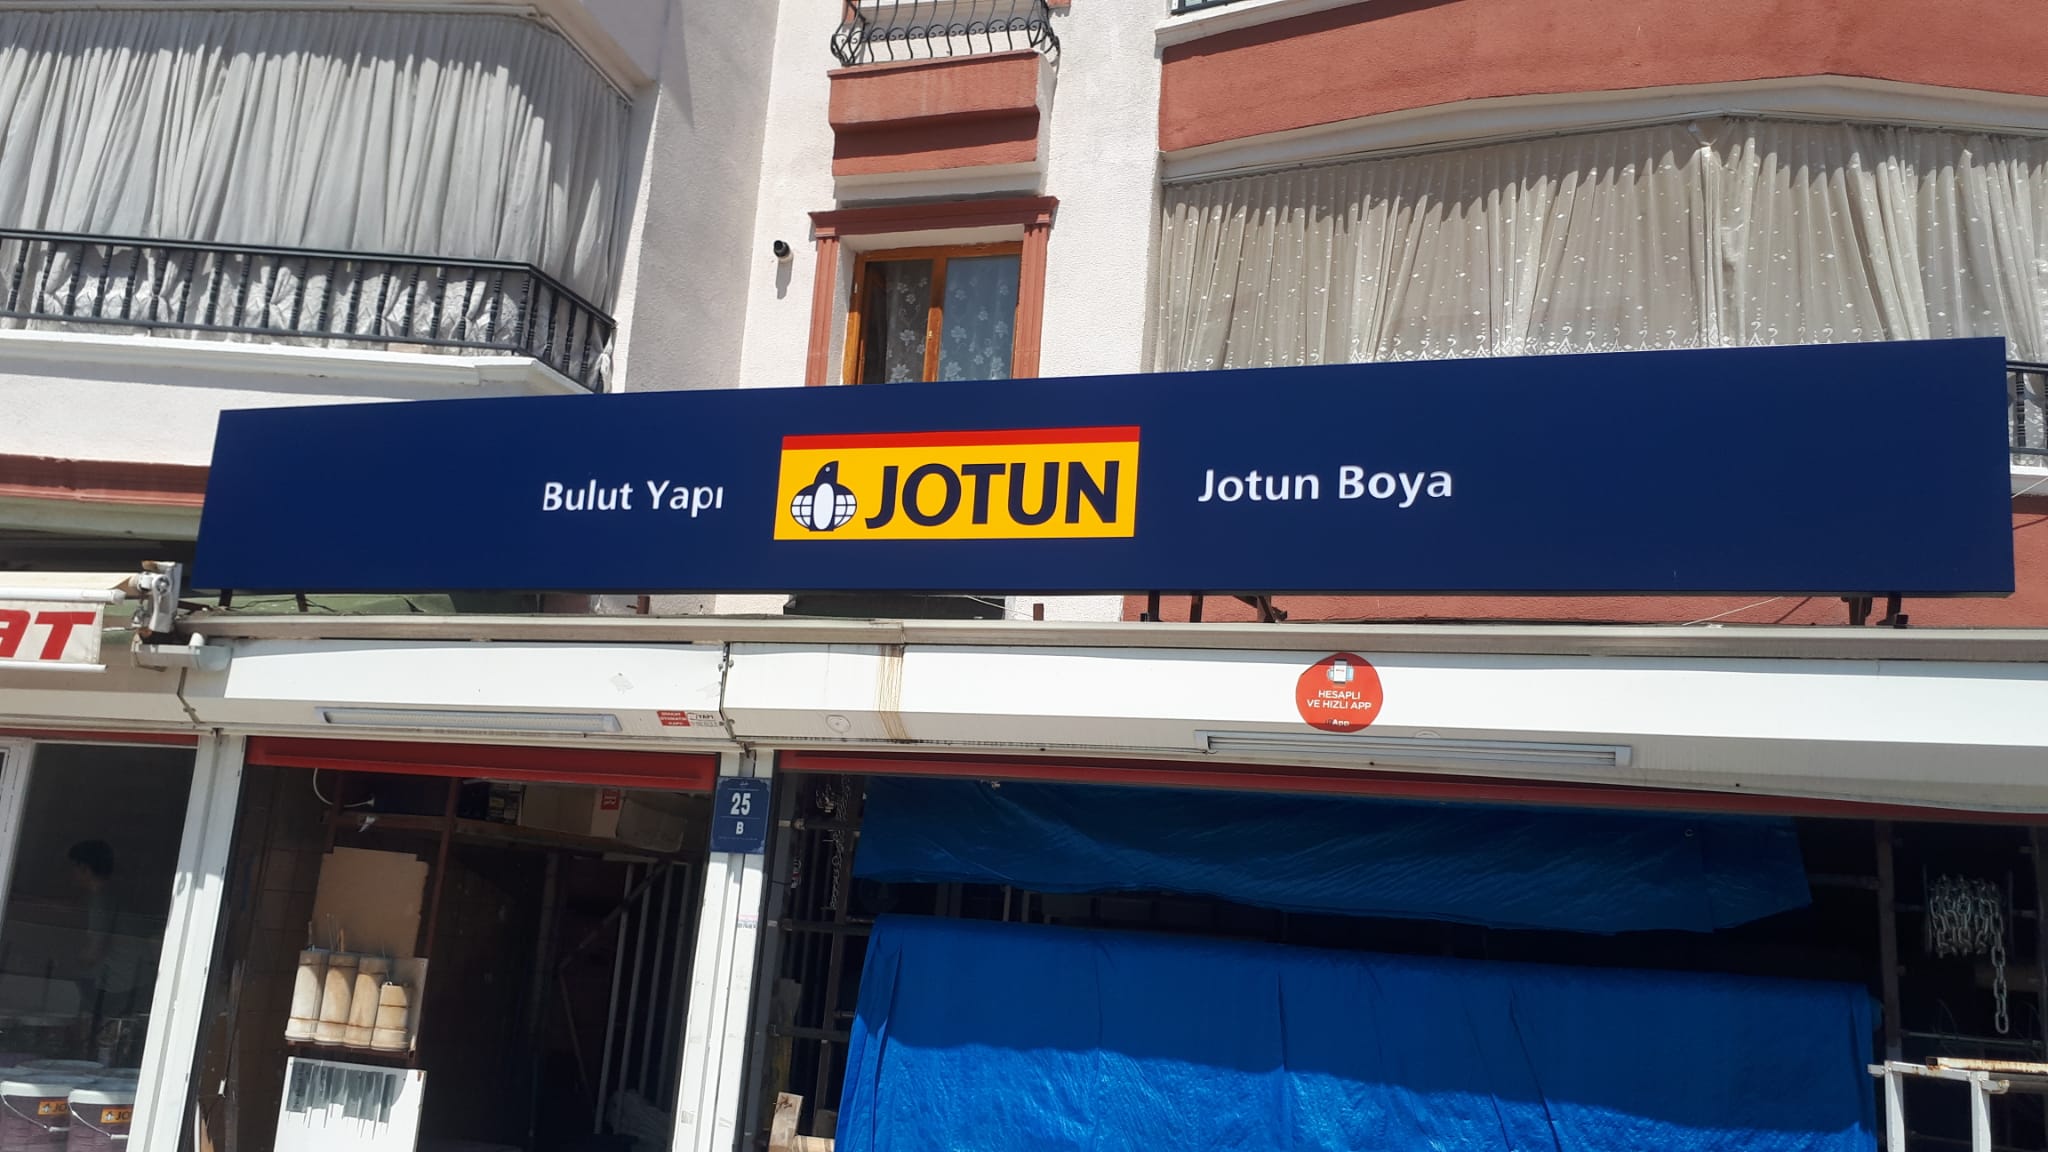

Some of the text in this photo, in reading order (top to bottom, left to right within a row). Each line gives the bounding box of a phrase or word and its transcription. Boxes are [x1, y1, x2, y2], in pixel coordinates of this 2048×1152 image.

[864, 460, 1120, 530] JOTUN
[1198, 465, 1452, 508] Jotun Boya
[543, 479, 724, 518] Bulut Yapı
[1306, 699, 1320, 708] VE
[1350, 702, 1372, 710] APP
[1318, 690, 1360, 700] HESAPLI
[730, 792, 751, 815] 25
[735, 821, 744, 835] B
